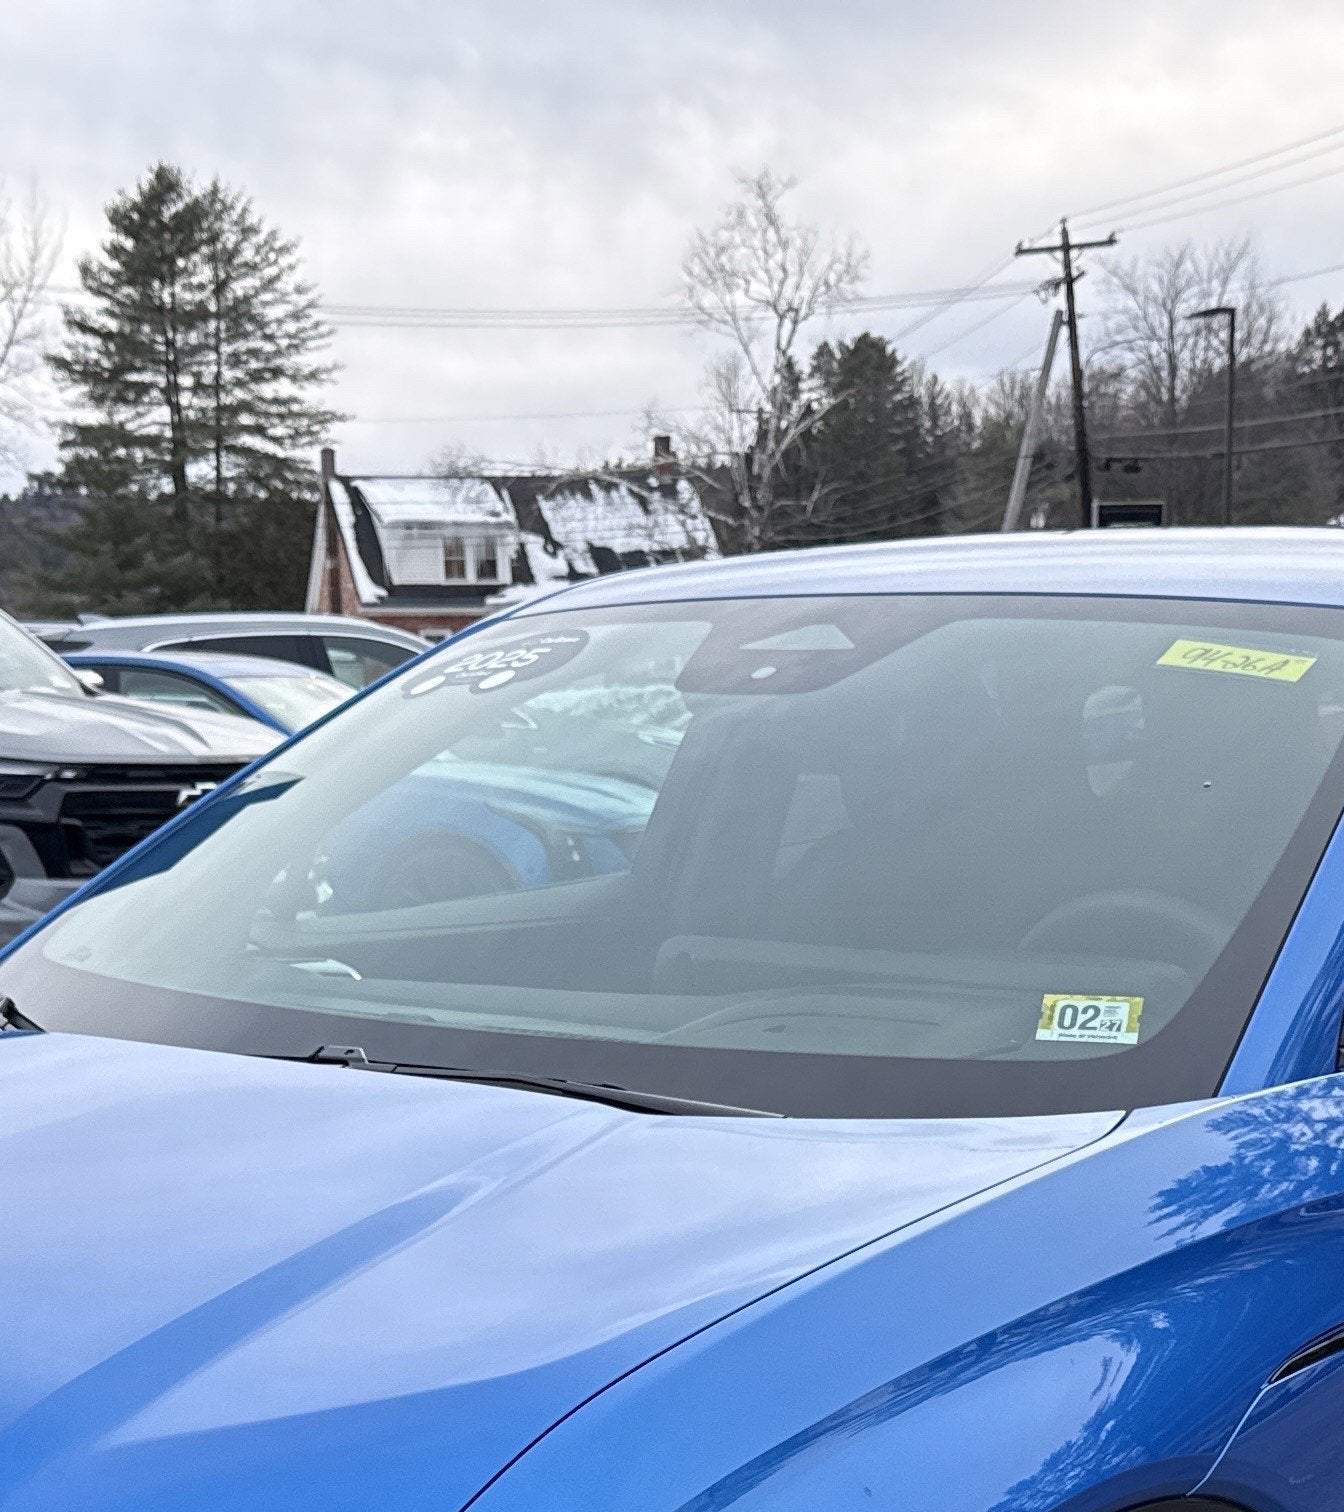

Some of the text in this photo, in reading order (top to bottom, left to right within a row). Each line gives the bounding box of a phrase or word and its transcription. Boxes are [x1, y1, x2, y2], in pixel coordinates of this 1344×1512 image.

[445, 648, 552, 674] 2025
[1057, 1004, 1101, 1030] 02
[1102, 1019, 1122, 1032] 27
